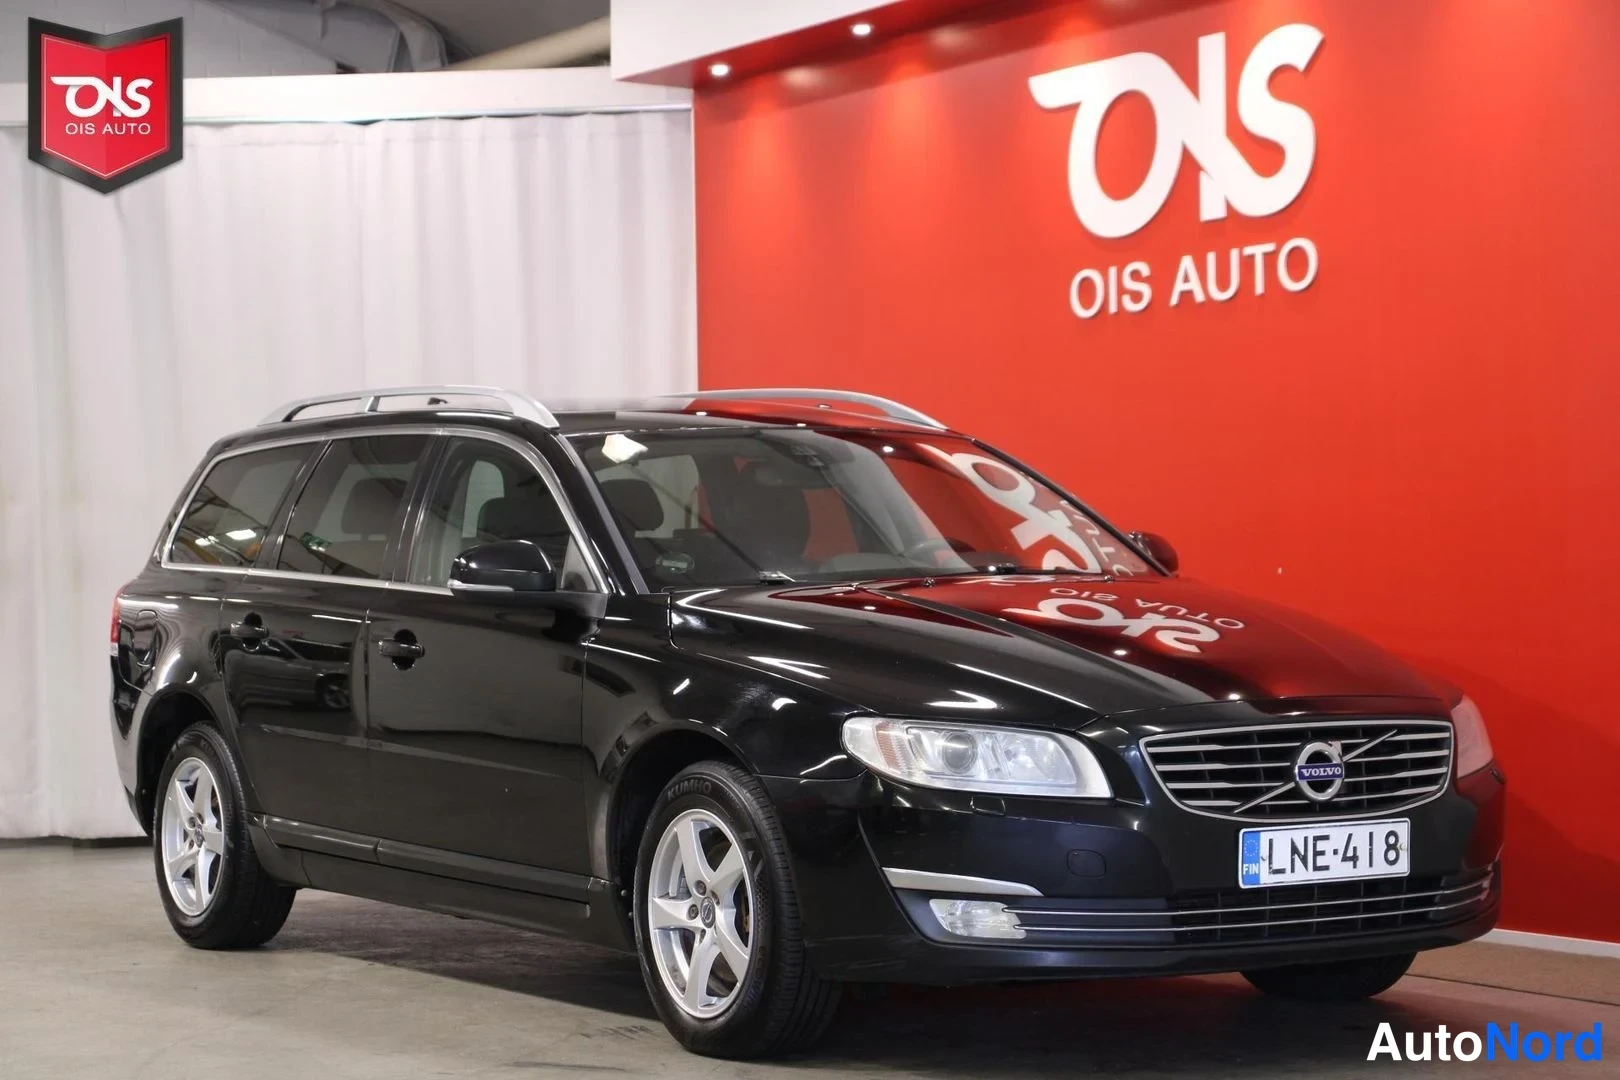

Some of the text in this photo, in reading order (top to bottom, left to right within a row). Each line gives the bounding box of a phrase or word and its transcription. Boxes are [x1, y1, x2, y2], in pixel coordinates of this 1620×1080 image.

[1028, 23, 1325, 239] OIS
[1069, 237, 1319, 319] OIS AUTO
[667, 779, 712, 801] KUMHO
[1300, 766, 1341, 777] VOLVO
[1243, 830, 1400, 875] FIN LNE-418
